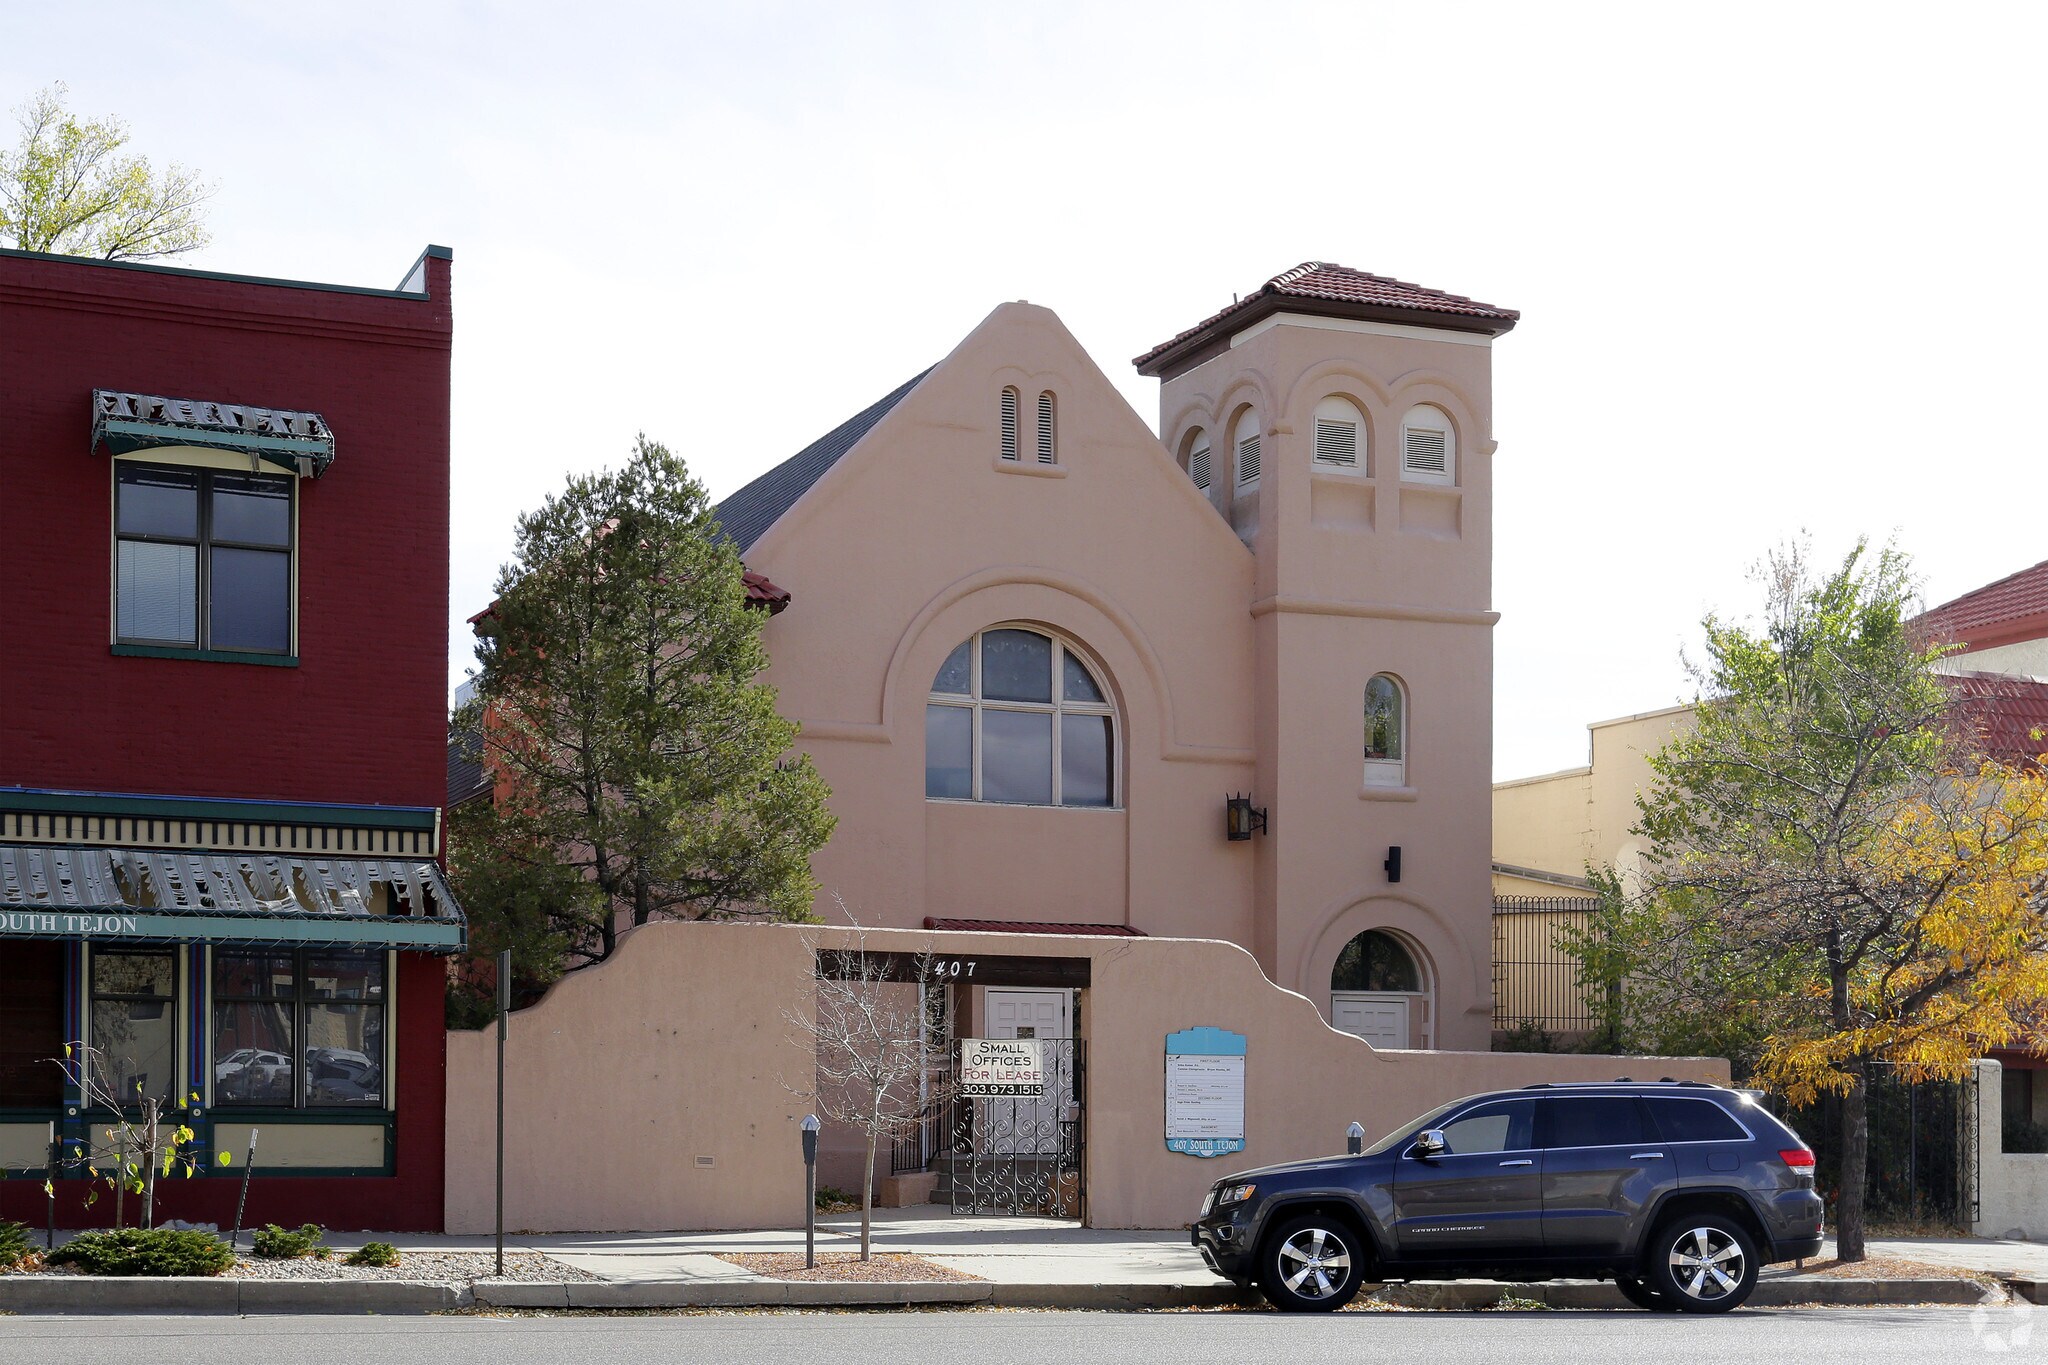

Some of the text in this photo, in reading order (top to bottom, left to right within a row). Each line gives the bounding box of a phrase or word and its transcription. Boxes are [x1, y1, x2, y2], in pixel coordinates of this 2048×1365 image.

[63, 915, 138, 933] TEJON
[934, 961, 976, 977] 407
[979, 1041, 1025, 1054] SMALL
[971, 1054, 1032, 1066] OFFICES
[964, 1068, 1041, 1080] FOR LEASE
[962, 1084, 1043, 1095] 303.973.1513
[1174, 1140, 1239, 1150] 407 SOUTH TEJON
